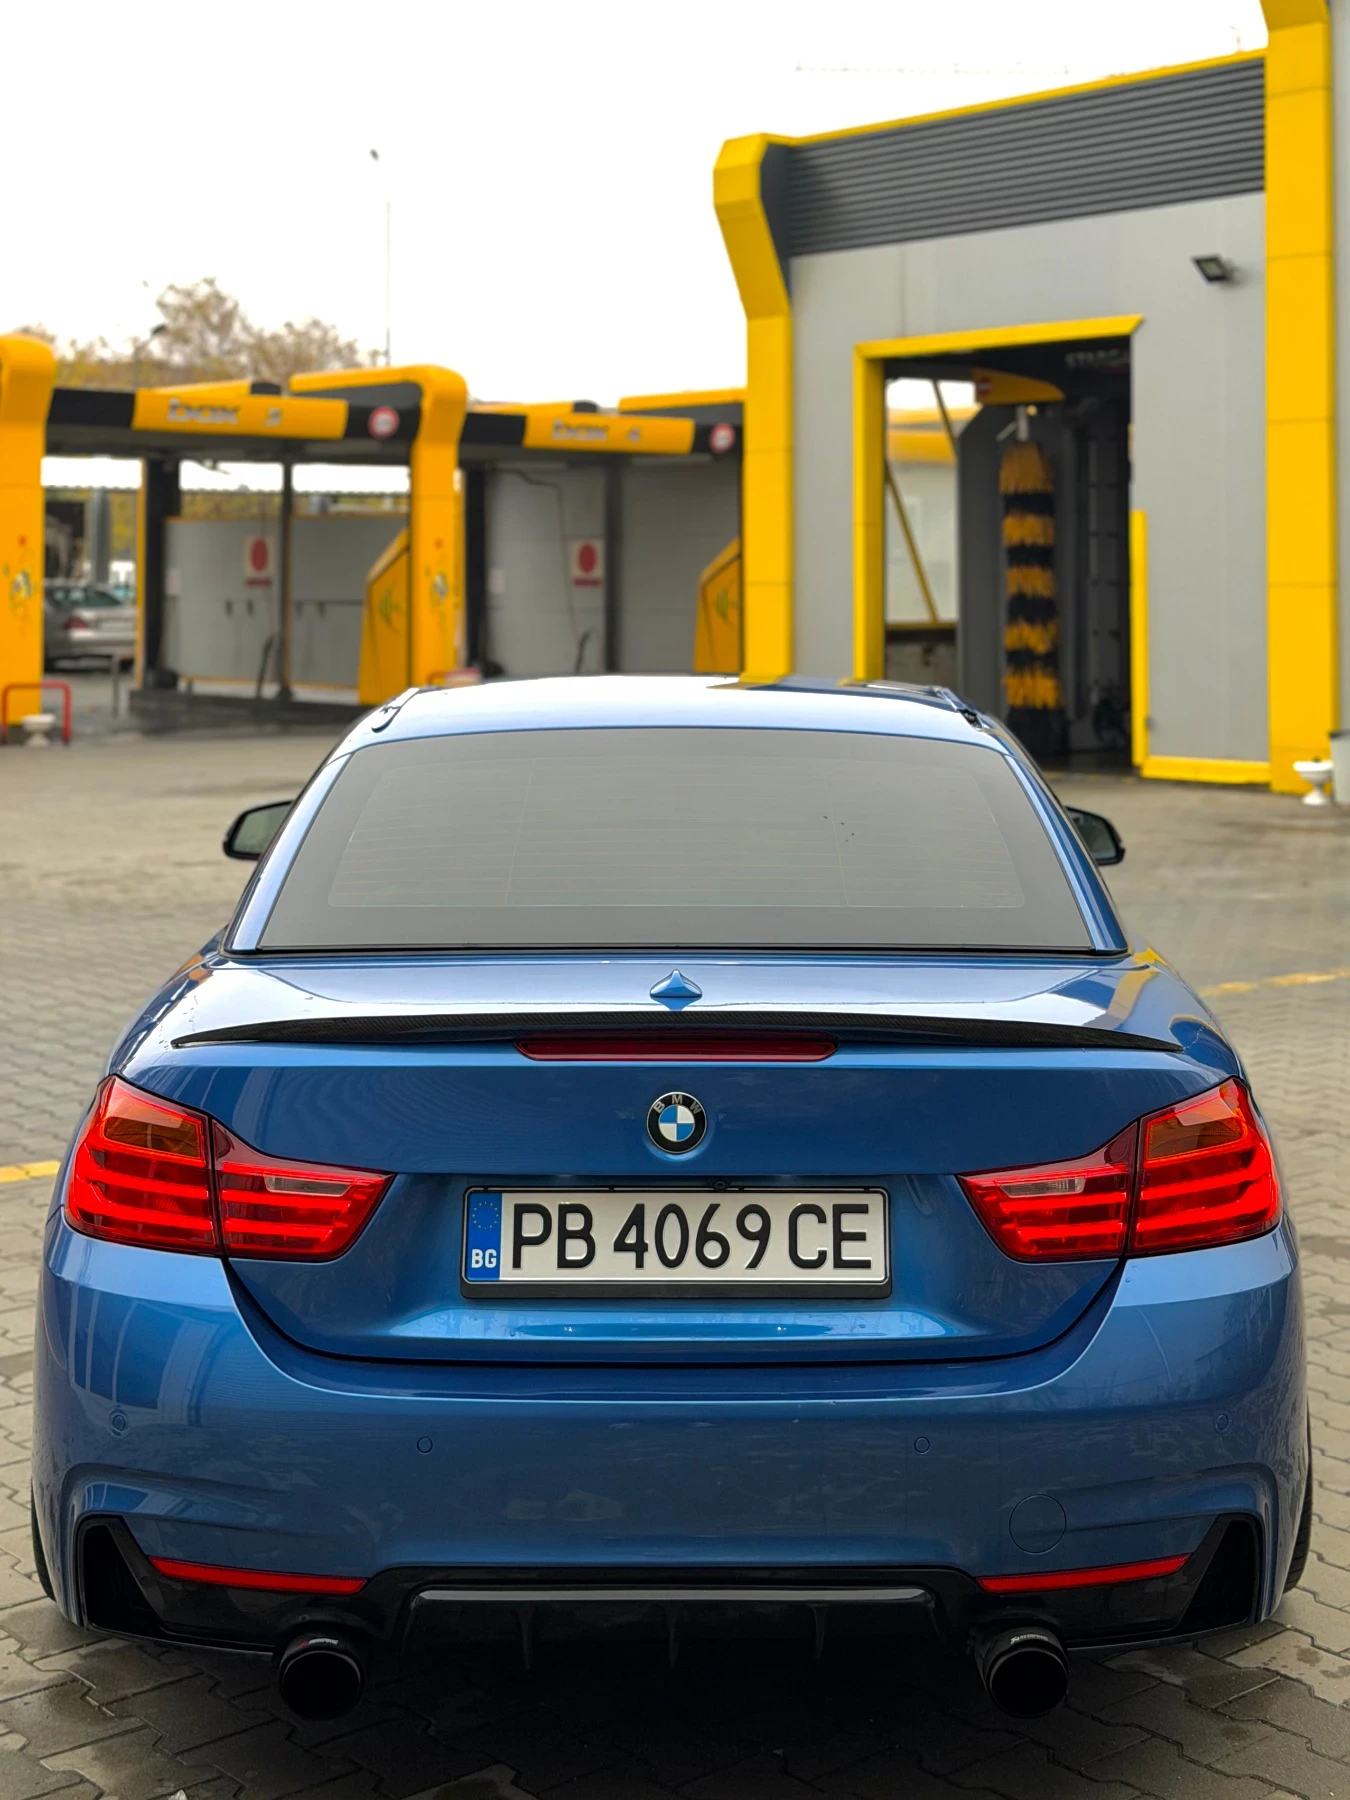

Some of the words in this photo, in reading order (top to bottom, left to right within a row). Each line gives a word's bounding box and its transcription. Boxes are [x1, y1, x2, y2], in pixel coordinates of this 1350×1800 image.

[653, 1094, 702, 1114] BMW
[512, 1203, 596, 1269] PB
[613, 1203, 771, 1269] 4069
[788, 1203, 872, 1269] CE
[471, 1249, 497, 1268] BG
